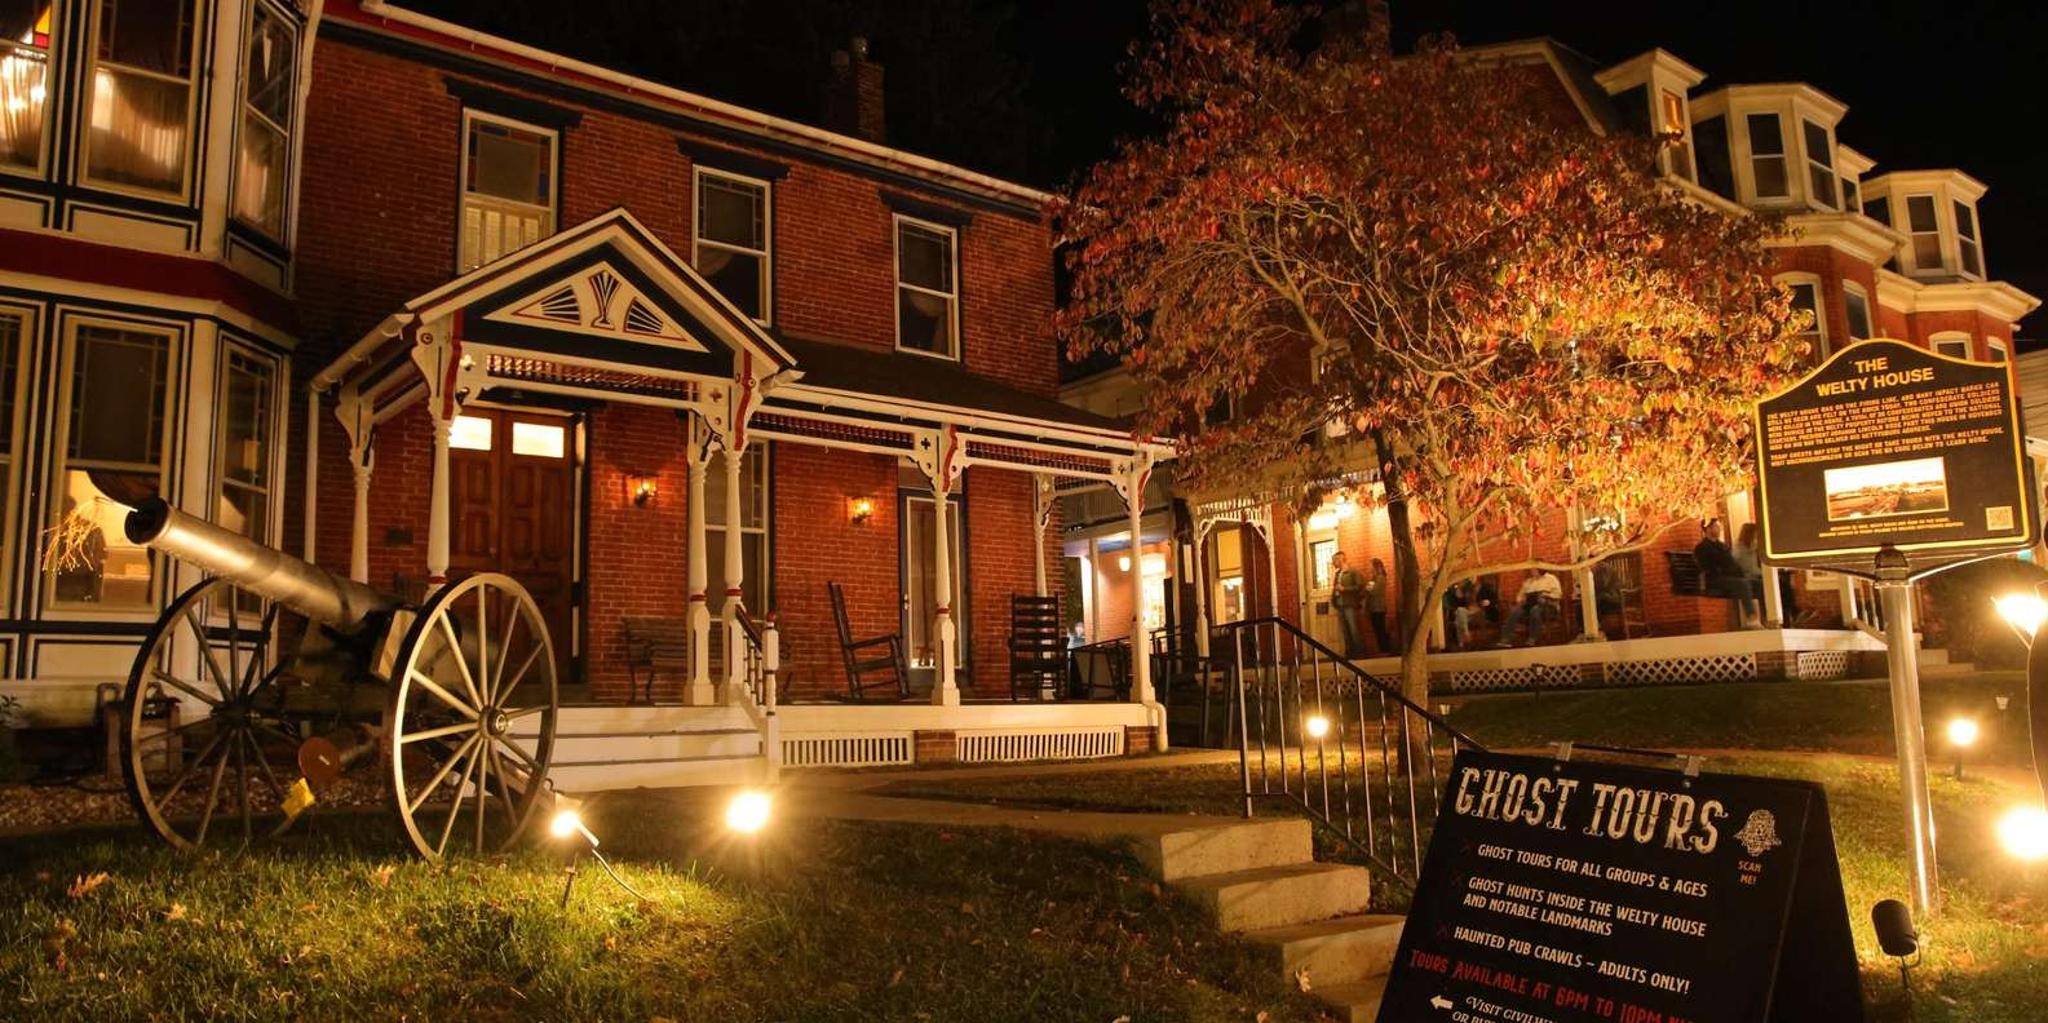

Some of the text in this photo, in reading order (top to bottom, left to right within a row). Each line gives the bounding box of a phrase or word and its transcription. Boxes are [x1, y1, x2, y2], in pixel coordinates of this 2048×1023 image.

[1816, 367, 1935, 396] WELTY HOUSE
[1854, 357, 1888, 373] THE
[1455, 767, 1728, 854] GHOST TOURS
[1478, 844, 1708, 897] GHOST TOURS FOR ALL GROUPS & AGES
[1738, 861, 1761, 872] SCAN
[1463, 893, 1613, 936] AND NOTABLE LANDMARKS
[1468, 877, 1707, 937] GHOST HUNTS INSIDE THE WELTY HOUSE
[1454, 926, 1505, 949] HAUNTED
[1507, 938, 1532, 955] PUB
[1534, 945, 1582, 967] CRAWLS
[1598, 960, 1647, 983] ADULTS
[1650, 973, 1690, 995] ONLY!
[1409, 949, 1662, 1023] TOURS AVAILABLE AT 6PM TO 10PM
[1465, 996, 1503, 1016] VISIT
[1452, 1011, 1469, 1023] OR
